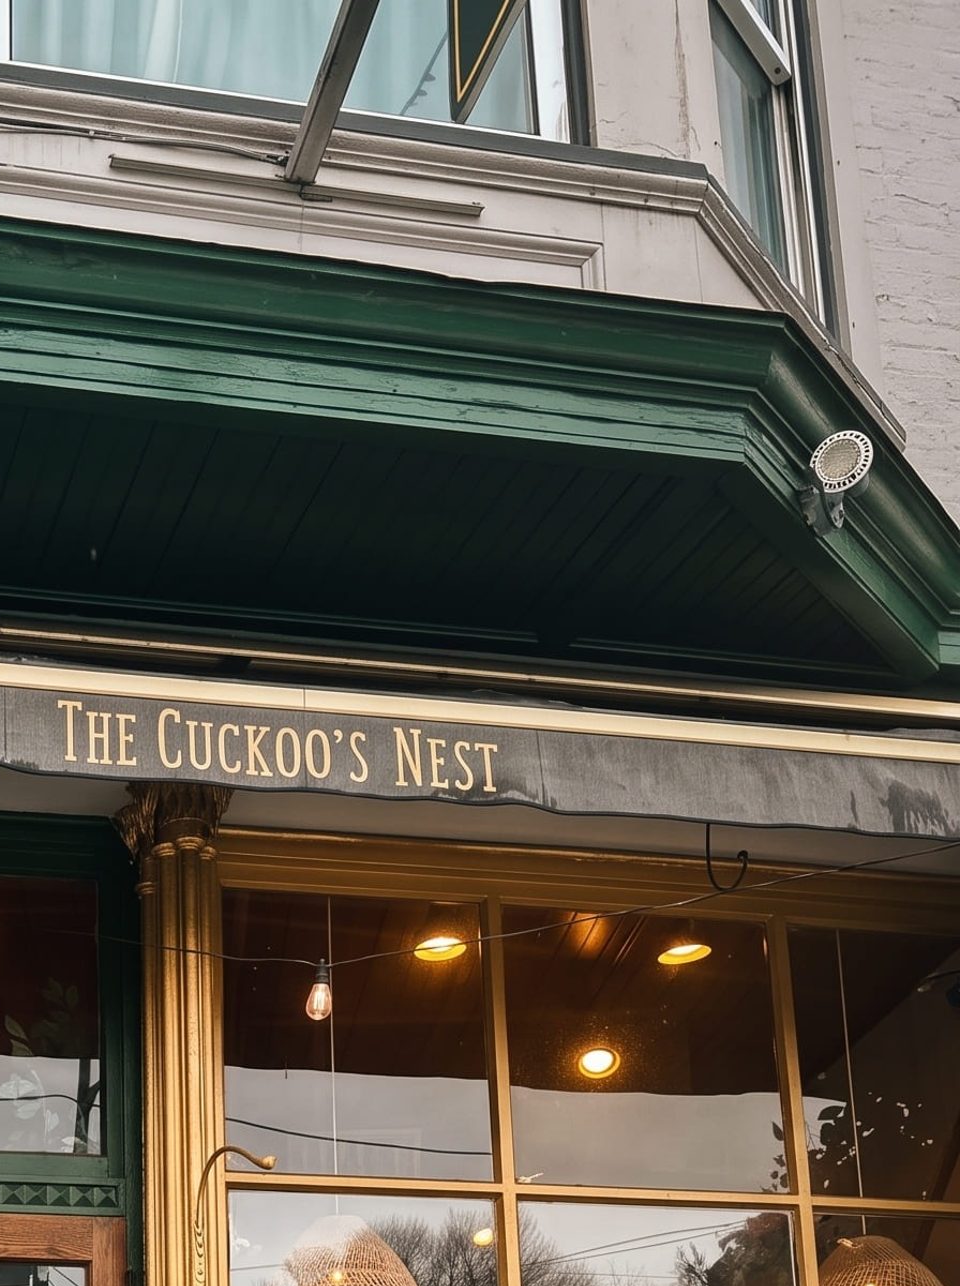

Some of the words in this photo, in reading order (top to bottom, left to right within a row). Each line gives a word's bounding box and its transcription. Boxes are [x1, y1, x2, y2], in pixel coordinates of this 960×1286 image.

[57, 699, 138, 766] THE
[157, 707, 370, 783] CUCKOO'S
[393, 726, 498, 793] NEST
